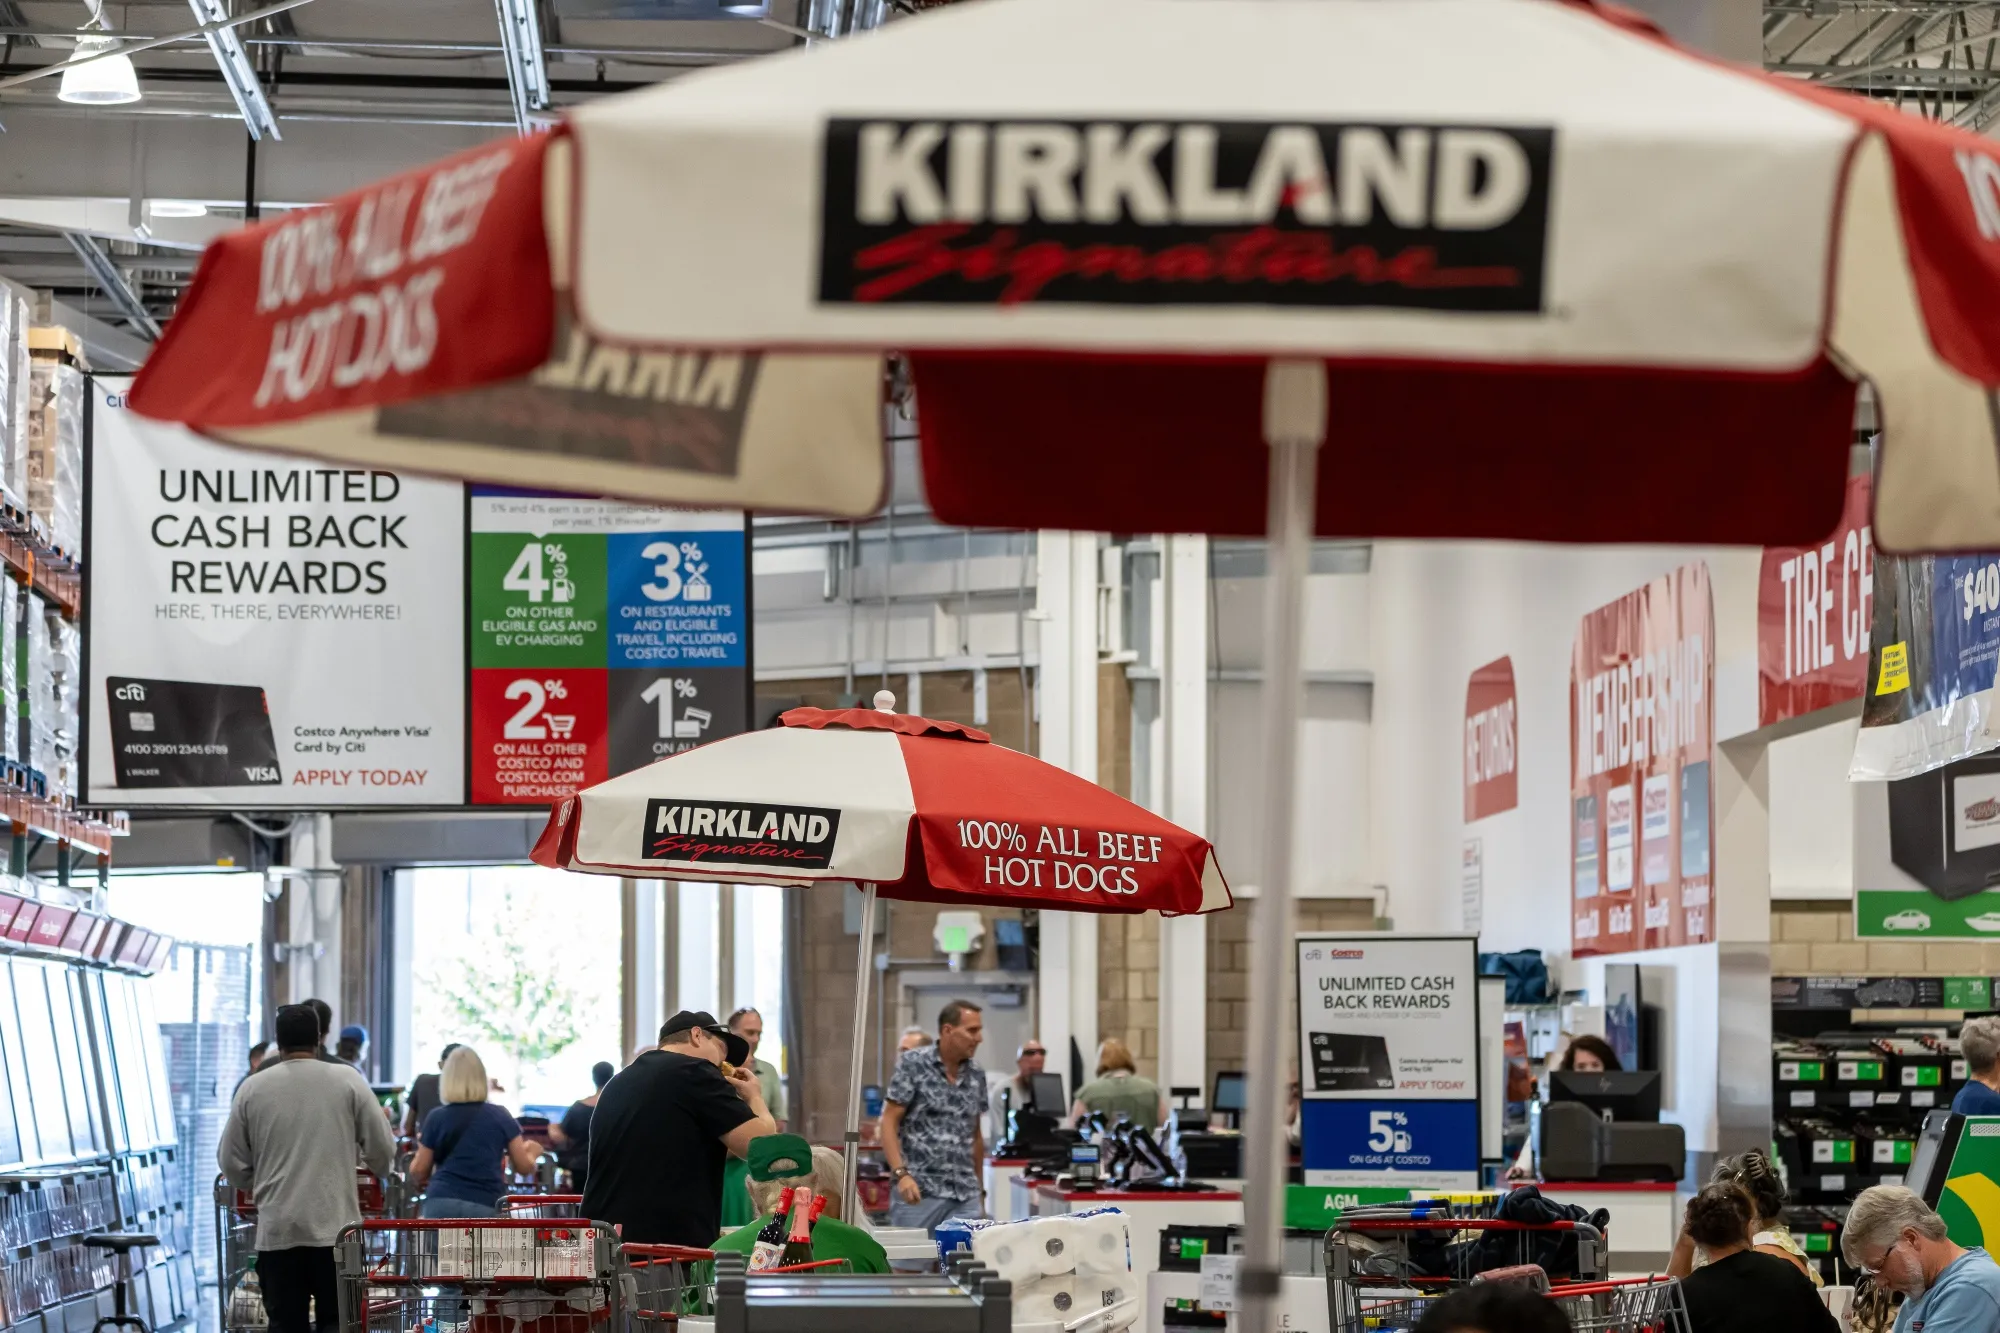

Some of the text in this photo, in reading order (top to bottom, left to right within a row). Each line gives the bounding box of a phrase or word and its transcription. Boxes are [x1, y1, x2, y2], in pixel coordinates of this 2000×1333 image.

[853, 121, 1532, 231] KIRKLAND
[854, 221, 1521, 310] Signature
[254, 266, 446, 409] HOT DOGS
[159, 469, 400, 503] UNLIMITED
[151, 514, 408, 548] CASH BACK
[170, 560, 388, 594] REWARDS
[1963, 562, 2000, 626] $40
[155, 604, 401, 622] HERE, THERE, EVERYWHERE!
[506, 606, 574, 618] ON OTHER
[620, 604, 732, 618] ON RESTAURANTS
[1780, 541, 1836, 681] TIRE
[482, 620, 597, 632] ELIGIBLE GAS AND
[633, 618, 718, 631] AND ELIGIBLE
[496, 634, 584, 646] EV CHARGING
[666, 632, 738, 645] INCLUDING
[625, 646, 727, 660] COSTCO TRAVEL
[115, 683, 145, 701] citi
[1577, 634, 1702, 779] MEMBERSHIP
[294, 726, 335, 737] Costco
[339, 726, 400, 739] Anywhere
[294, 742, 366, 755] Card by Citi
[652, 741, 675, 754] ON
[1466, 697, 1516, 785] RETURNS
[124, 744, 151, 755] 4100
[152, 744, 177, 755] 3901
[493, 743, 587, 756] ON ALL OTHER
[497, 757, 584, 770] COSTCO AND
[244, 767, 279, 781] VISA
[293, 769, 428, 786] APPLY TODAY
[495, 770, 585, 783] COSTCO.COM
[503, 785, 577, 797] PURCHASES
[655, 805, 830, 843] KIRKLAND
[957, 818, 1162, 863] 100% ALL BEEF
[653, 834, 825, 863] Signature
[984, 855, 1139, 895] HOT DOGS
[1305, 949, 1322, 961] citi
[1318, 976, 1455, 991] UNLIMITED CASH
[1323, 994, 1451, 1009] BACK REWARDS
[1399, 1080, 1465, 1090] APPLY TODAY
[1349, 1155, 1431, 1165] ON GAS AT COSTCO
[1324, 1194, 1359, 1210] AGM
